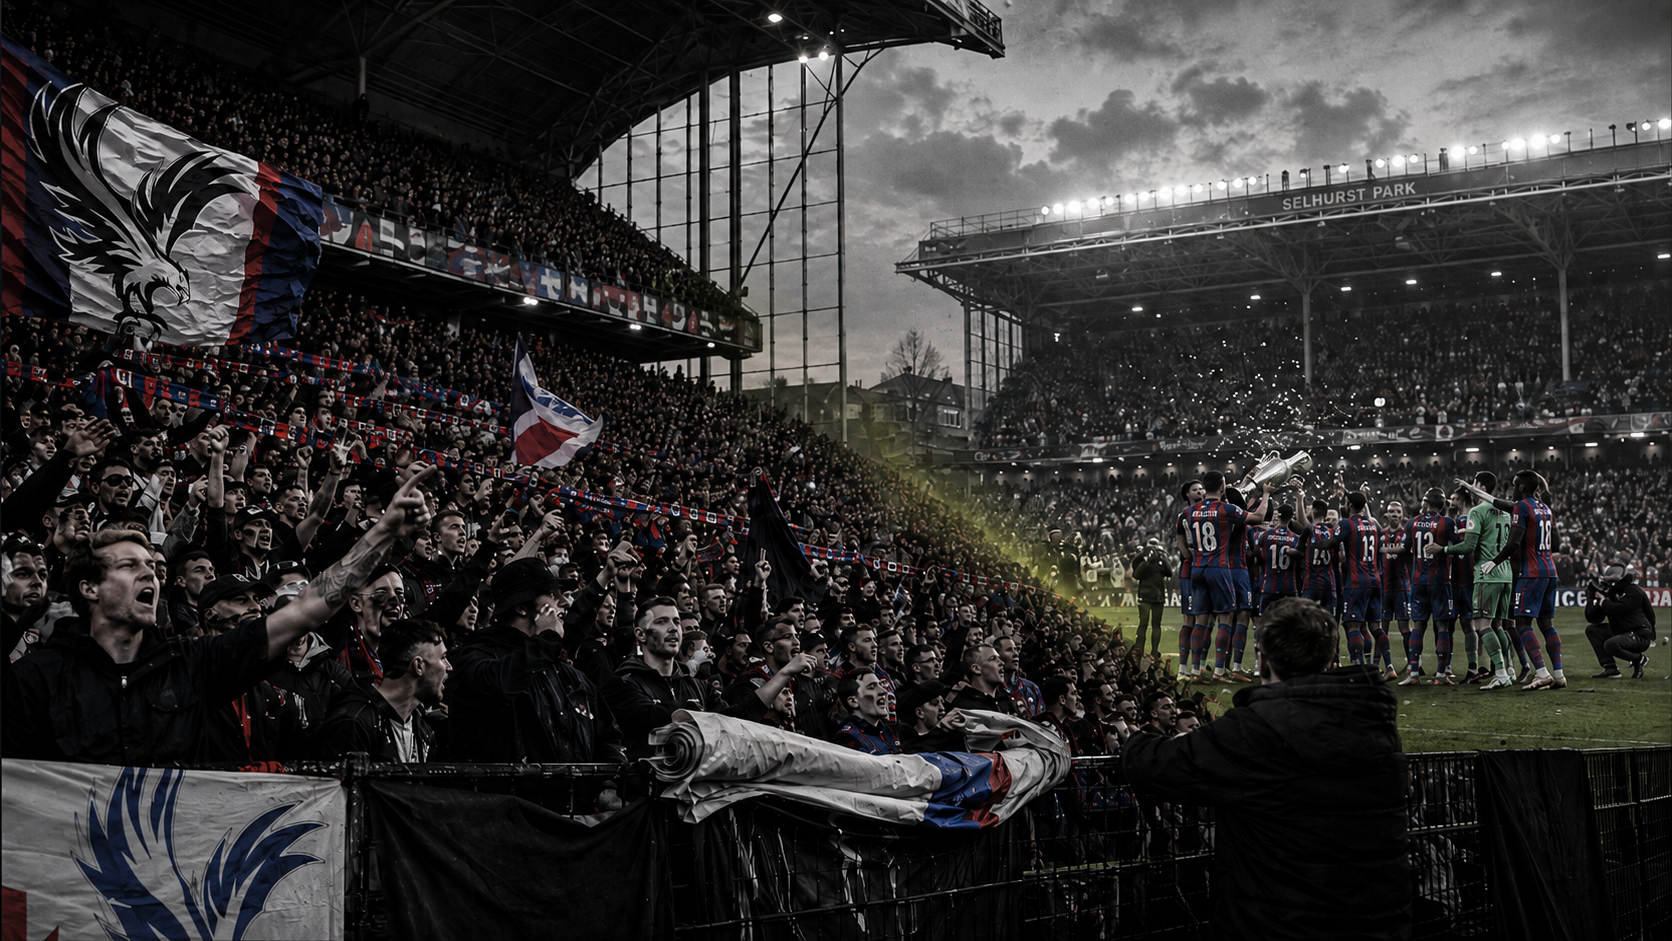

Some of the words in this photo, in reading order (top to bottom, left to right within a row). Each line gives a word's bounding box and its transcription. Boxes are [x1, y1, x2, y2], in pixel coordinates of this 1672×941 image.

[1282, 188, 1366, 211] SELHURST
[1373, 181, 1416, 200] PARK
[1192, 521, 1218, 552] 18
[1362, 535, 1375, 562] 13
[1269, 544, 1292, 570] 16
